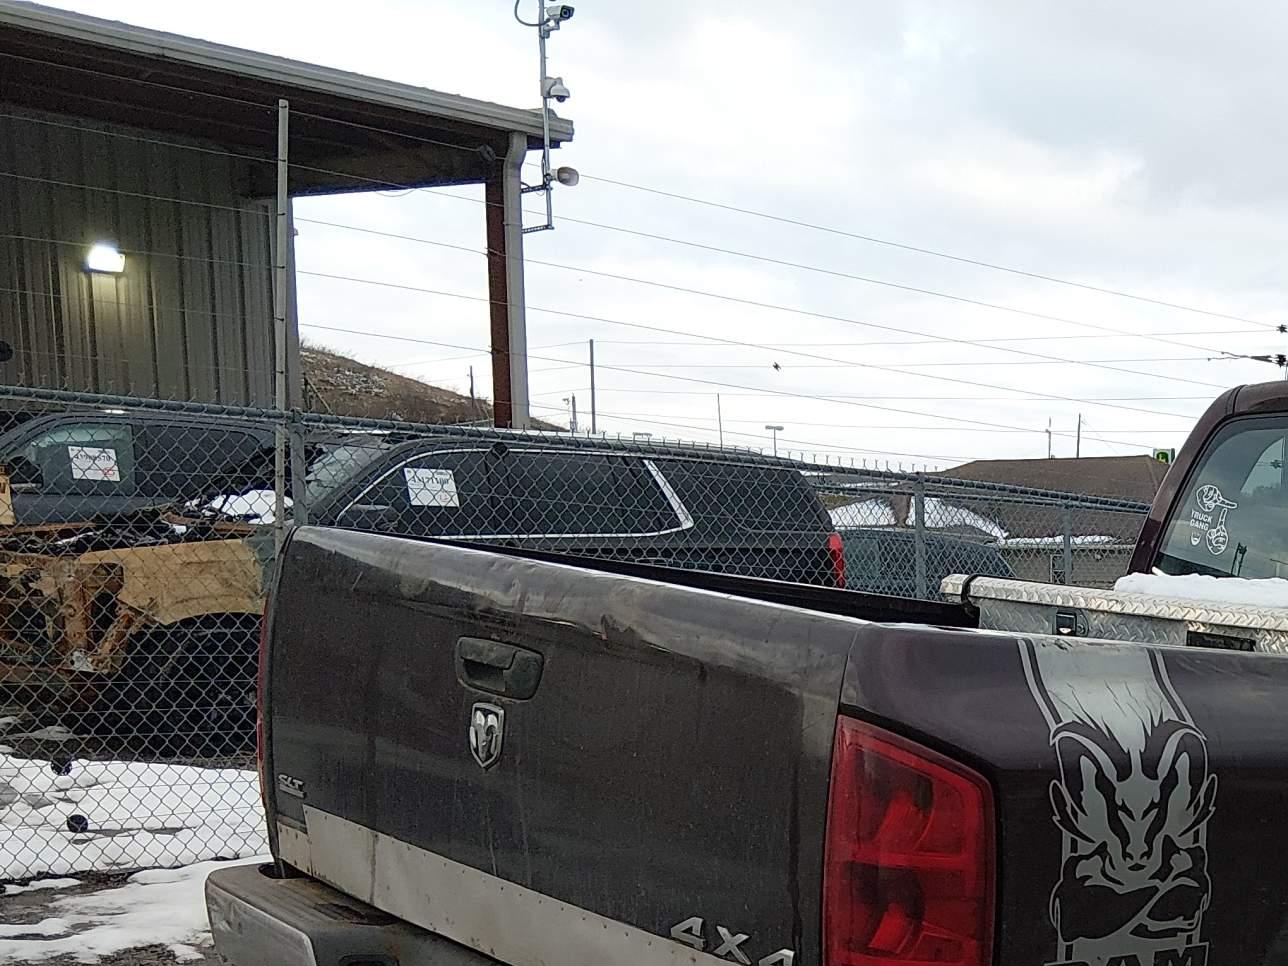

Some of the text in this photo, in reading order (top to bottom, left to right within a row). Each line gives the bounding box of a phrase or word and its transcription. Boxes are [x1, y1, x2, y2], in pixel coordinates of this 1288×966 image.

[1190, 519, 1209, 531] GANG
[1191, 509, 1213, 525] TRUCK
[278, 774, 304, 790] SLT
